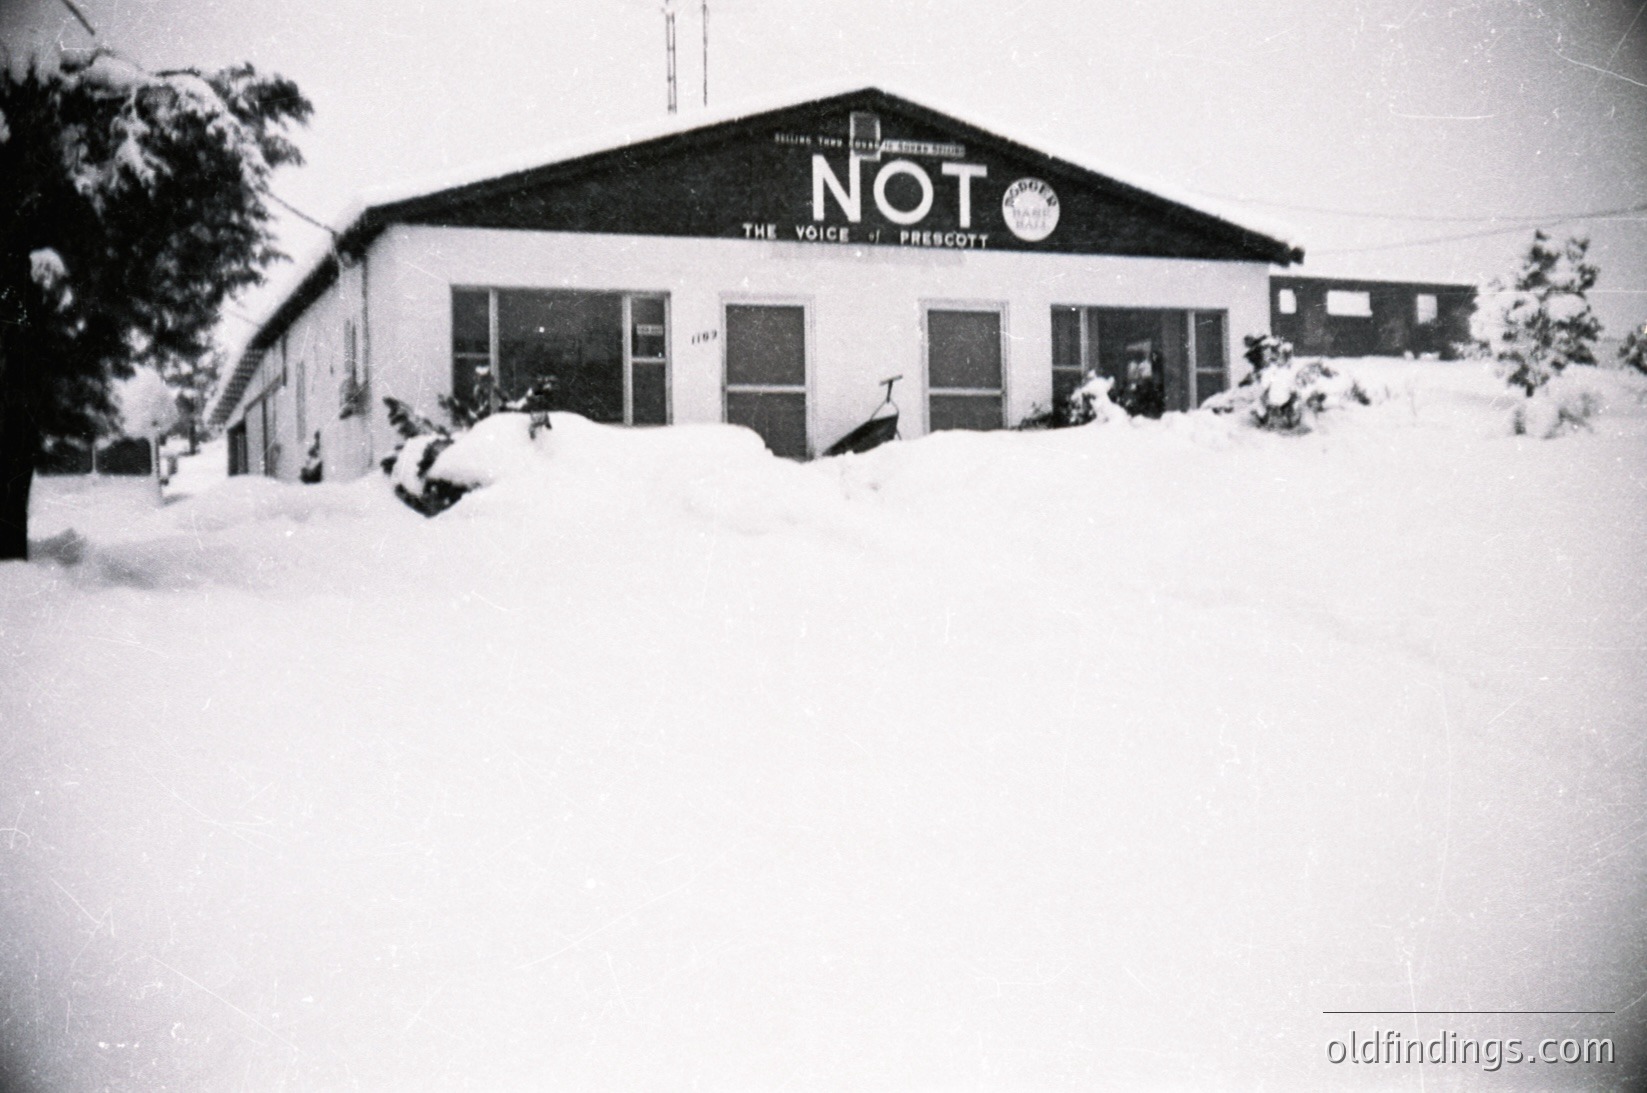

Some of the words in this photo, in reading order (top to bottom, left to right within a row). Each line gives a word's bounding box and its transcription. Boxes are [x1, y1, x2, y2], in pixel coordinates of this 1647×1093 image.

[812, 154, 987, 229] NOT
[743, 222, 776, 239] THE
[795, 225, 850, 242] VOICE
[868, 229, 881, 244] of
[900, 230, 989, 248] PRESCOTT
